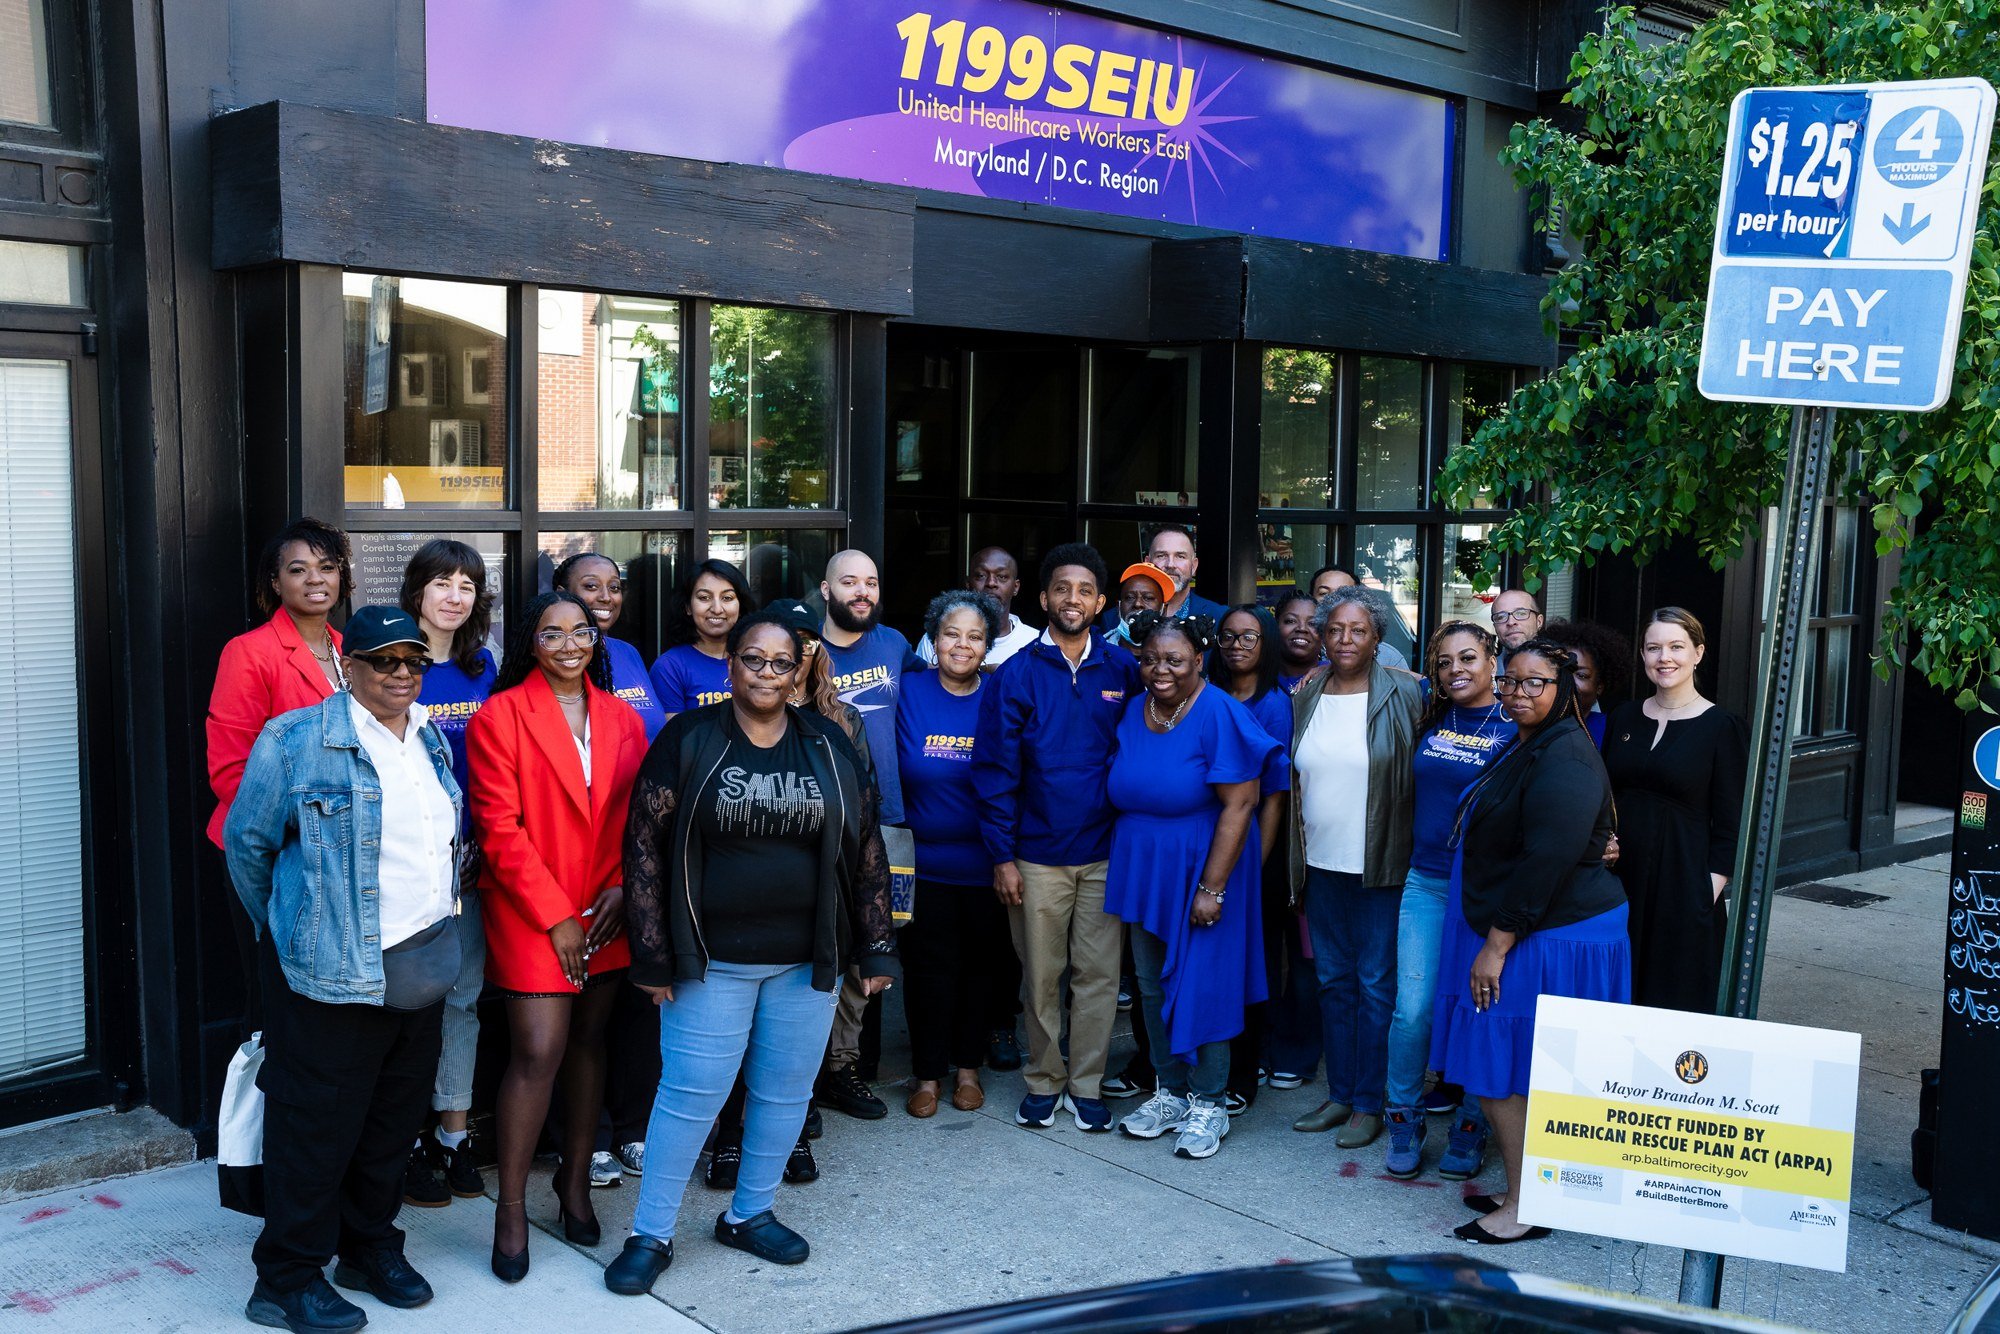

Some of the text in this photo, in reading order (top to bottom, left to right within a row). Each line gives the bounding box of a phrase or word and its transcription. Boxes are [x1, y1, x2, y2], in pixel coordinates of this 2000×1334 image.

[896, 12, 1195, 126] 1199SEIU
[897, 87, 1190, 161] United Healthcare Workers East
[1895, 109, 1942, 159] 4
[1748, 116, 1857, 199] $1.25
[934, 136, 1159, 198] Maryland / D.C. Region
[1891, 162, 1938, 172] HOURS
[1889, 173, 1938, 181] MAXIMUM
[1736, 208, 1840, 236] per hour
[1765, 286, 1889, 328] PAY
[1735, 339, 1905, 386] HERE
[361, 533, 384, 542] King's
[362, 544, 395, 552] Coretta
[396, 543, 420, 552] Scott
[396, 554, 413, 562] Balt
[363, 565, 405, 574] help Local
[364, 575, 399, 585] organize
[366, 596, 400, 605] Hopkins
[832, 665, 888, 688] 99SEIU
[925, 735, 975, 748] 1199SE
[1423, 748, 1442, 758] Good
[1441, 753, 1459, 761] Jobs
[1459, 756, 1474, 764] For
[1963, 795, 1986, 808] GOD
[1962, 806, 1986, 816] HATES
[1962, 813, 1985, 825] TAGS
[893, 874, 914, 892] EW
[1602, 1080, 1781, 1116] Mayor Brandon M. Scott
[1606, 1107, 1765, 1143] PROJECT FUNDED BY
[1544, 1119, 1833, 1177] AMERICAN RESCUE PLAN ACT (ARPA)
[1621, 1152, 1749, 1179] arp.baltimorecity.gov
[1560, 1176, 1603, 1188] PROGRAMS
[1561, 1170, 1603, 1182] RECOVERY
[1644, 1179, 1722, 1198] #ARPAinACTION
[1635, 1189, 1729, 1211] #BuildBetterBmore
[1789, 1210, 1837, 1226] AMERICAN
